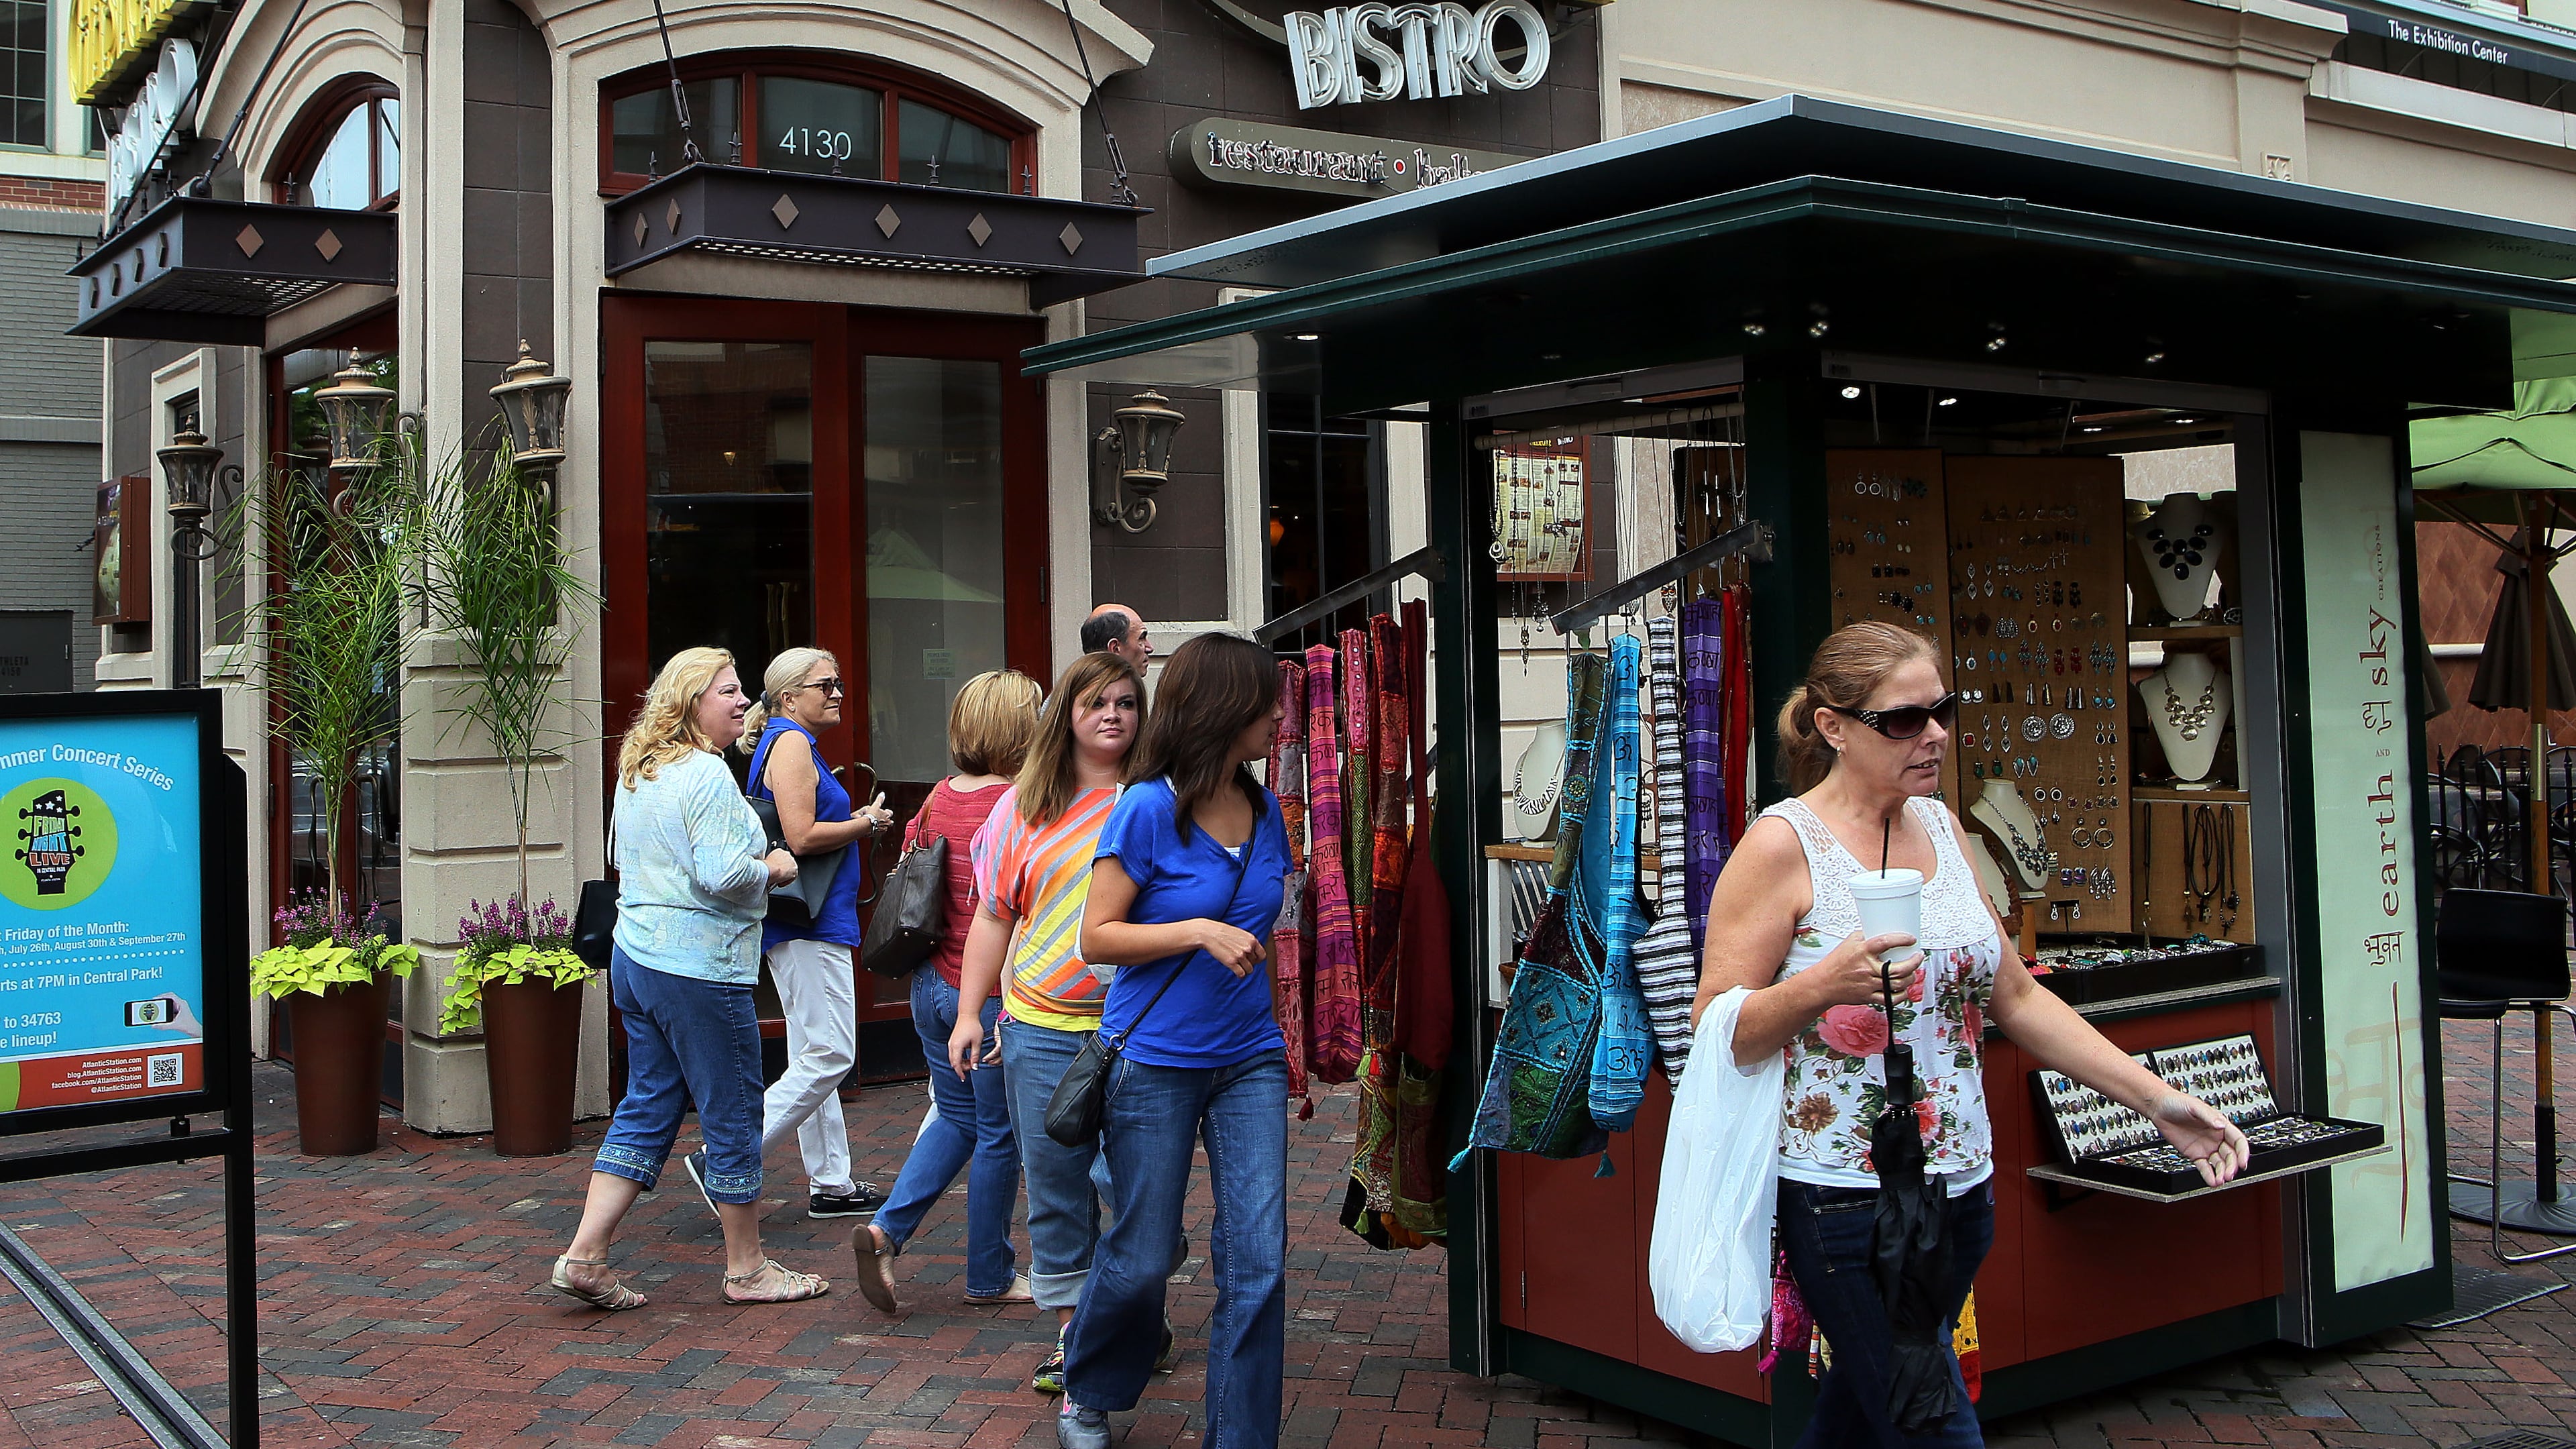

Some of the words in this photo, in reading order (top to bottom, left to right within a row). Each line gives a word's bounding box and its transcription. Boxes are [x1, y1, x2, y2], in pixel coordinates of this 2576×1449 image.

[2387, 19, 2409, 42] The
[2413, 25, 2469, 56] Exhibition
[2471, 40, 2508, 64] Center
[1283, 0, 1550, 110] BISTRO
[778, 126, 852, 160] 4130
[1208, 134, 1388, 183] restaurant
[2374, 524, 2384, 600] CREATIONS
[2359, 604, 2396, 686] sky
[2375, 749, 2390, 757] AND
[52, 744, 121, 769] Concert
[123, 756, 174, 791] Series
[34, 815, 65, 837] FRIDAY
[2367, 769, 2399, 917] earth
[29, 852, 70, 866] LIVE
[5, 928, 44, 941] Friday
[48, 926, 61, 938] of
[64, 924, 84, 936] the
[87, 920, 129, 935] Month:
[9, 944, 28, 955] July
[30, 942, 53, 953] 26th,
[54, 939, 86, 951] August
[88, 938, 107, 948] 30th
[109, 937, 117, 947] &
[118, 934, 165, 947] September
[166, 932, 186, 942] 27th
[21, 977, 34, 989] at
[37, 974, 65, 988] 7PM
[68, 973, 80, 985] in
[84, 969, 127, 985] Central
[131, 966, 162, 981] Park!
[3, 1016, 17, 1029] to
[21, 1012, 62, 1028] 34763
[11, 1031, 57, 1047] lineup!
[67, 1066, 142, 1079] blog.AtlanticStation.com
[82, 1057, 142, 1069] AtlanticStation.com
[52, 1074, 142, 1089] facebook.com/AtlanticStation
[91, 1083, 142, 1093] @AtlanticStation
